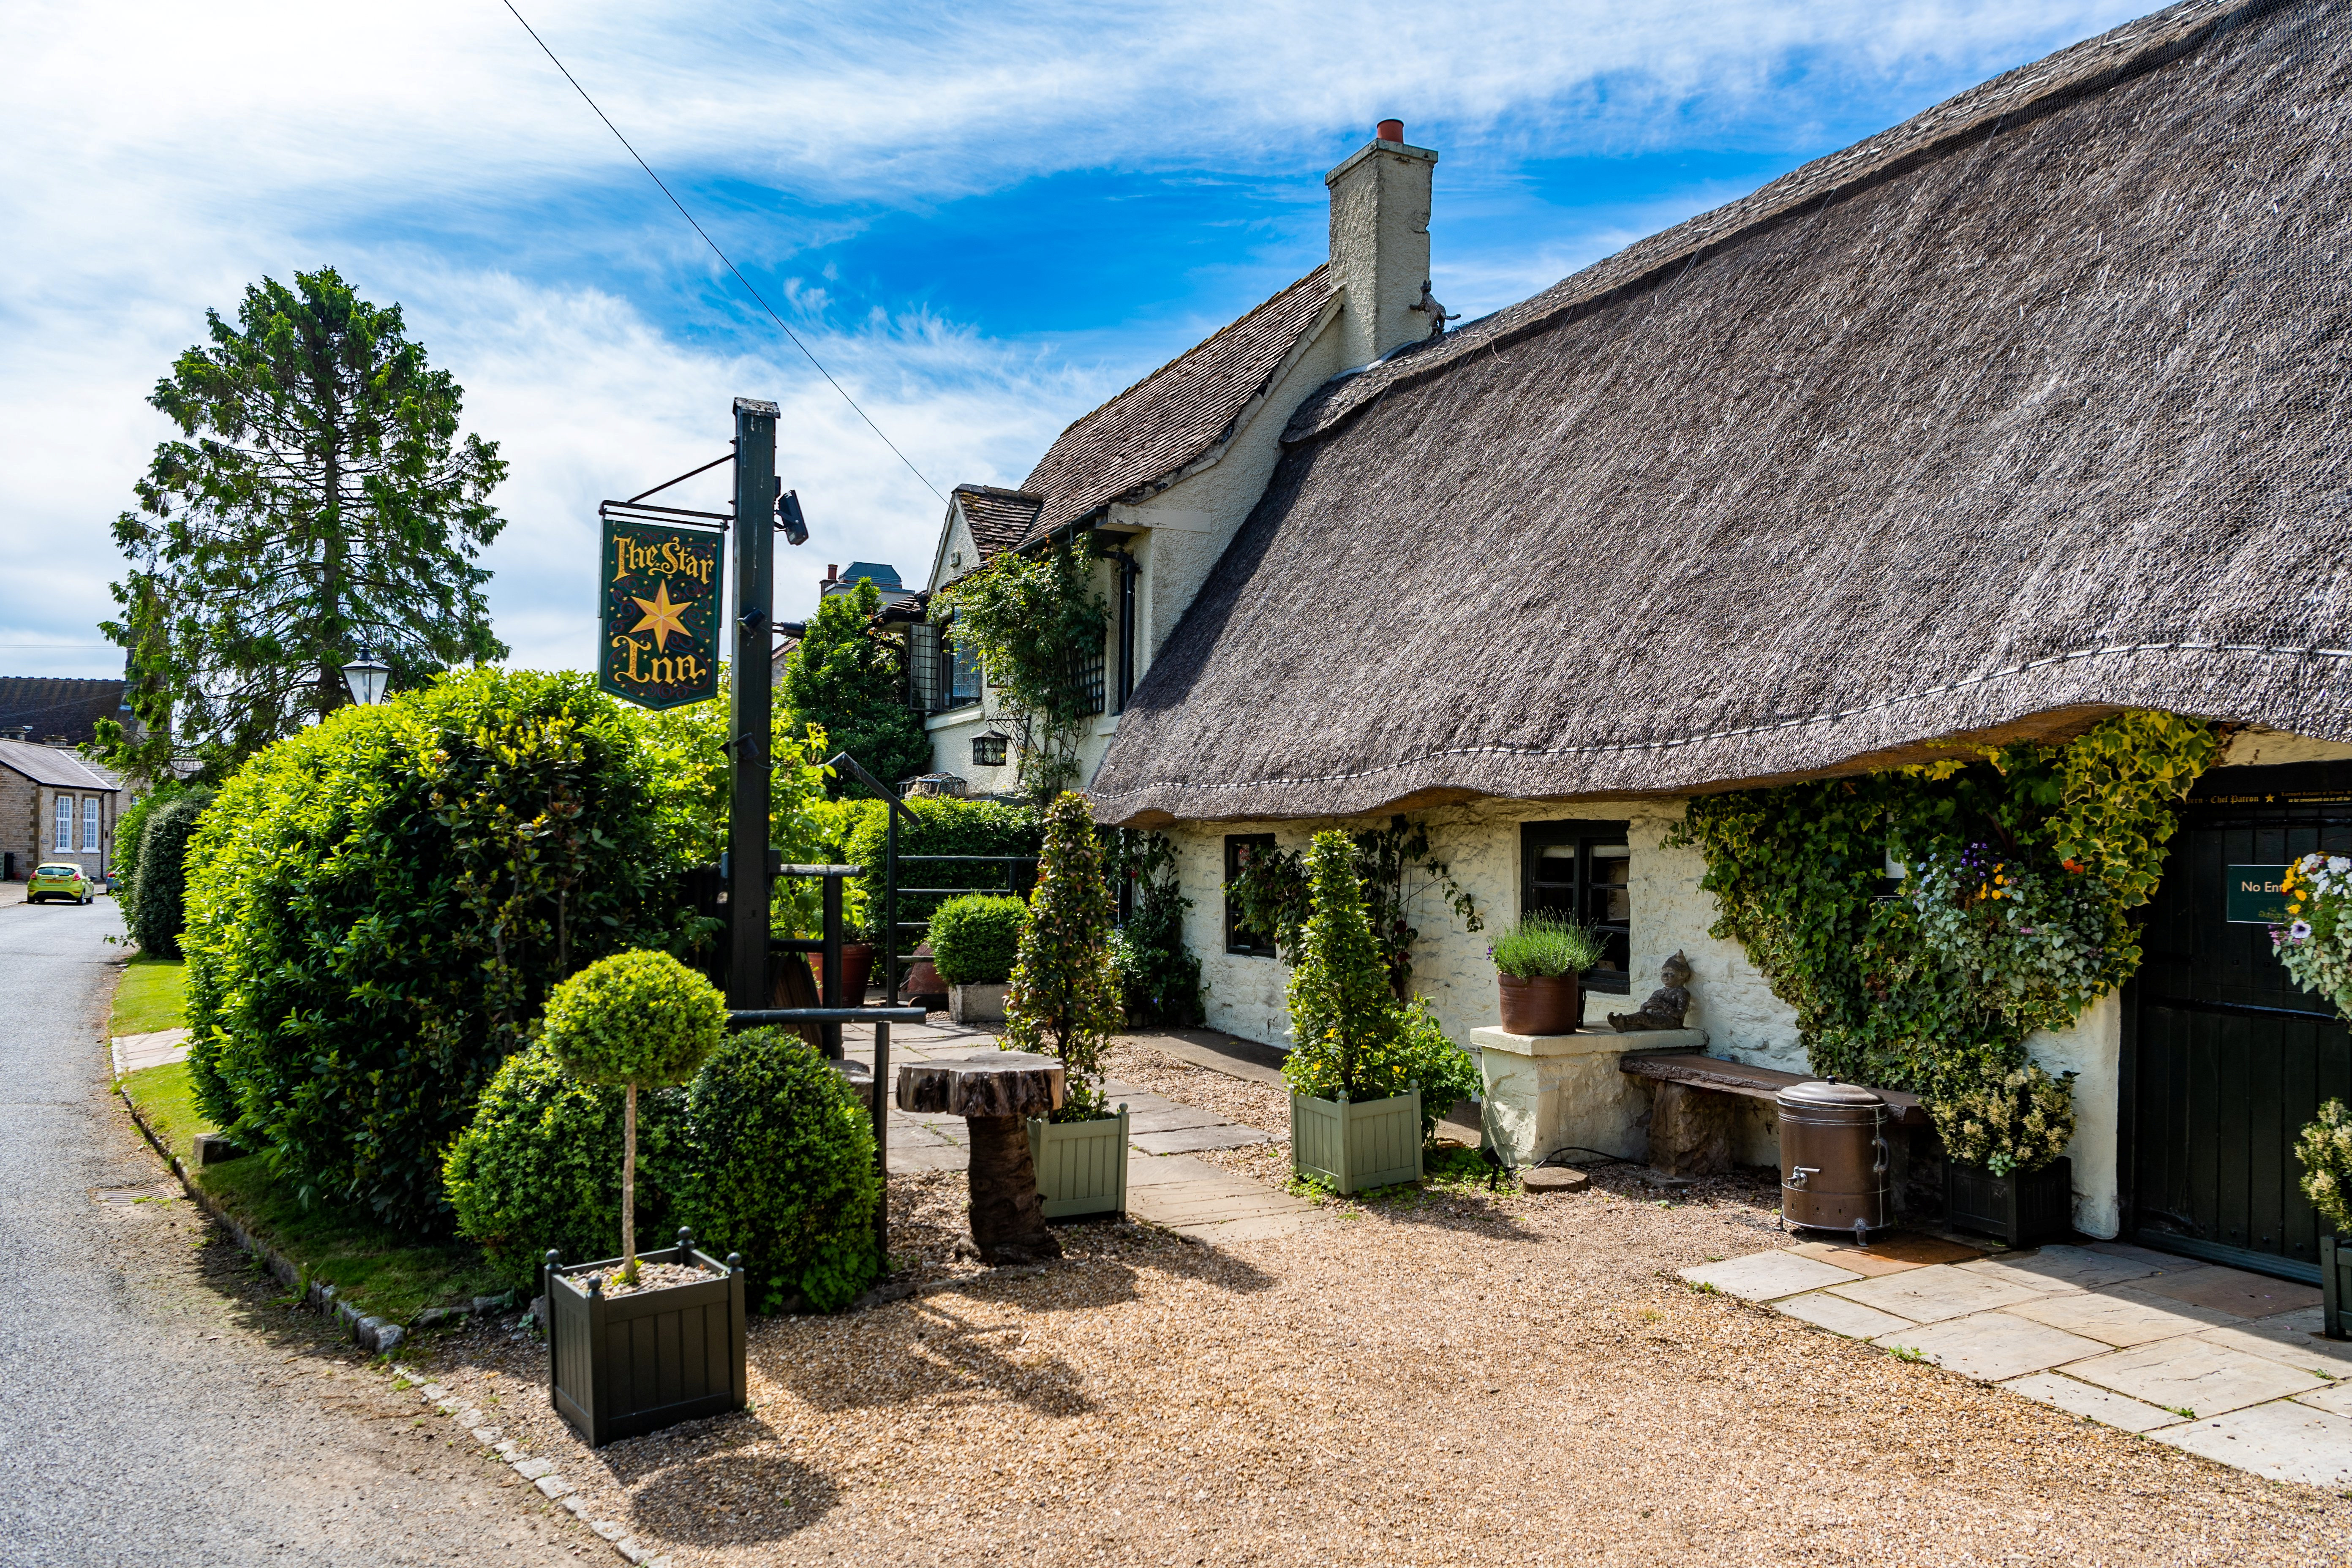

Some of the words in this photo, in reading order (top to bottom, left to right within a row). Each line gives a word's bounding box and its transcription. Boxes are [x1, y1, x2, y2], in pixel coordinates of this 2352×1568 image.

[612, 534, 659, 582] The
[648, 537, 714, 584] Star
[612, 635, 706, 684] Inn
[2210, 795, 2228, 803] Chef
[2230, 795, 2259, 804] Patron
[2241, 882, 2261, 892] No
[2265, 882, 2283, 892] Ent
